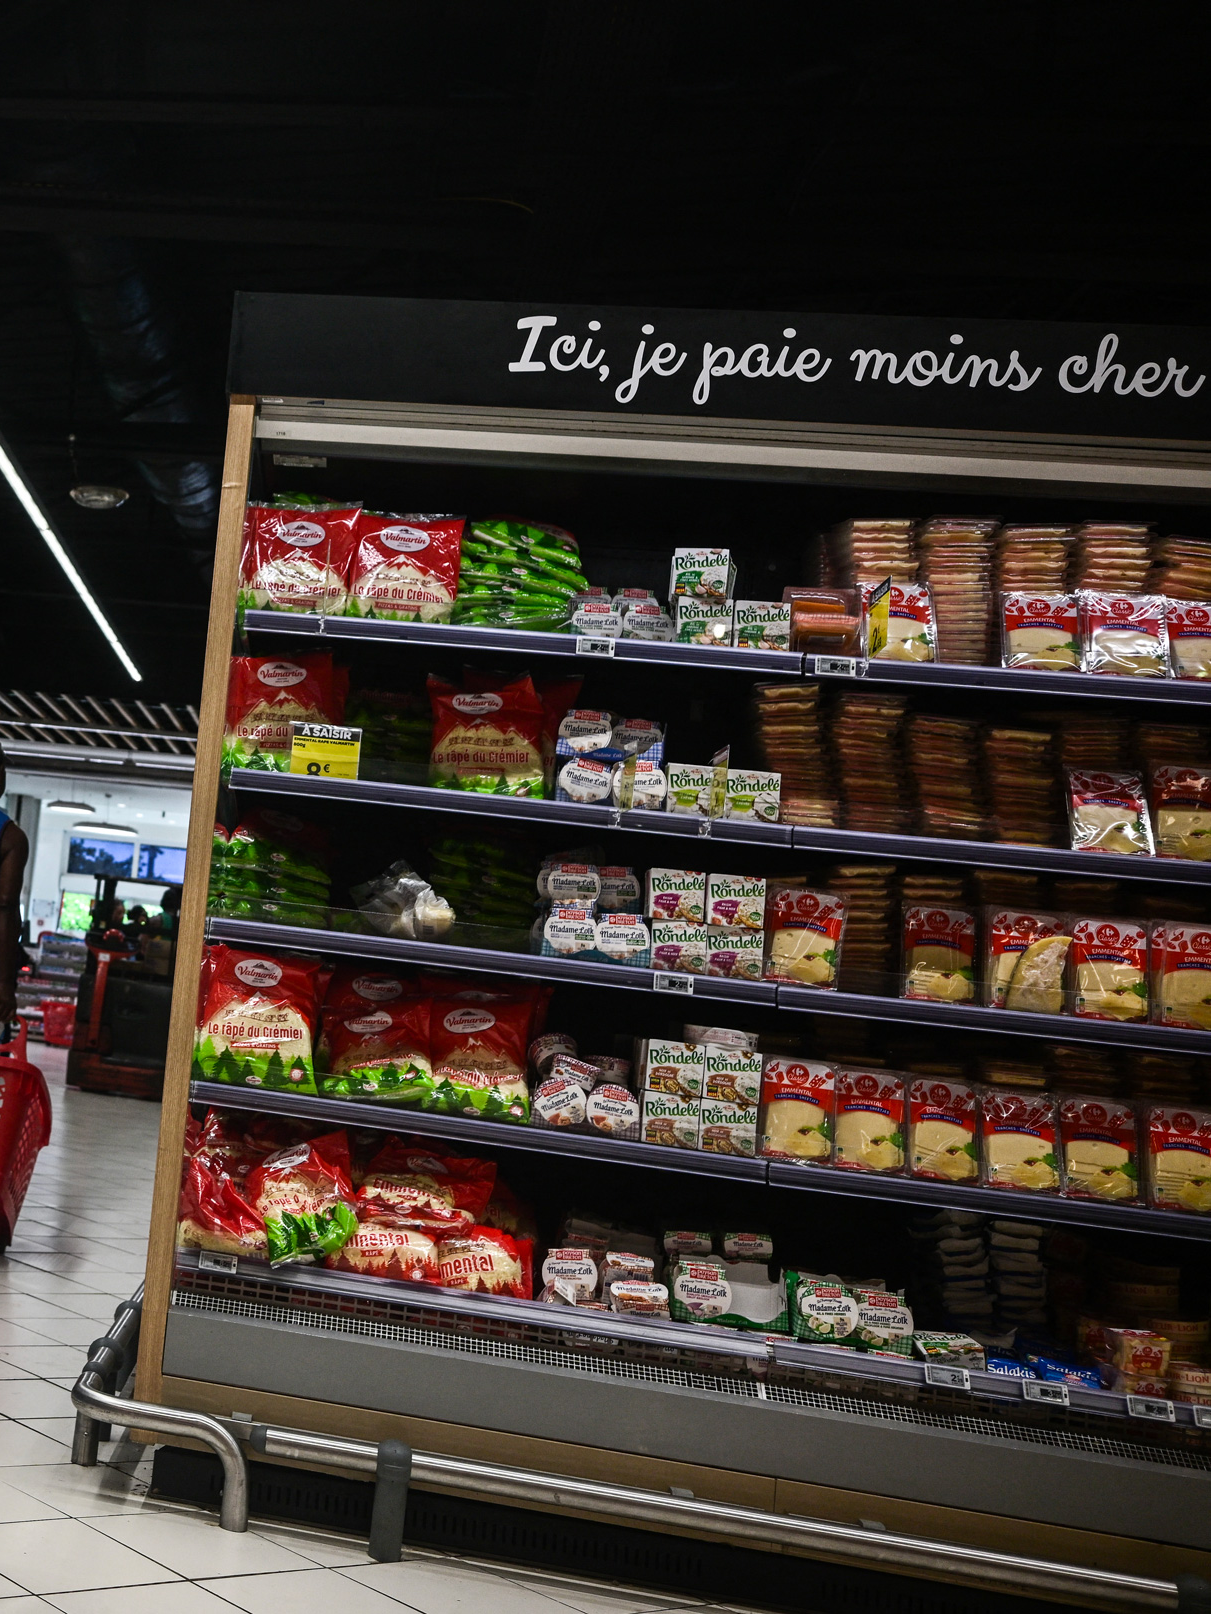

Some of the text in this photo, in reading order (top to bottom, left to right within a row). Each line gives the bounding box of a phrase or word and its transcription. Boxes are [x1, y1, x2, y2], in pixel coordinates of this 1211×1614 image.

[508, 315, 1207, 406] Ici, je paie moins cher
[383, 533, 427, 545] Valmartin
[675, 553, 728, 571] Rondelé
[392, 587, 404, 599] du
[679, 602, 732, 620] Rondelé
[736, 607, 790, 625] Rondelé
[575, 617, 603, 626] Madame
[627, 618, 654, 627] Madame
[260, 669, 304, 680] Valmartin
[456, 697, 500, 708] Valmartin
[237, 725, 248, 738] Le
[276, 726, 288, 737] du
[312, 727, 352, 740] SAISIR
[564, 724, 593, 733] Madame
[433, 751, 444, 763] Le
[446, 749, 470, 766] râpé
[473, 751, 485, 763] du
[489, 748, 530, 763] Crémier
[324, 763, 330, 773] €
[566, 770, 594, 782] Madame
[670, 773, 711, 789] Ronde
[727, 777, 780, 794] Rondelé
[552, 877, 580, 886] Madame
[652, 877, 705, 892] Rondelé
[710, 883, 765, 898] Rondelé
[549, 924, 578, 933] Madame
[600, 930, 629, 939] Madame
[652, 928, 707, 943] Rondelé
[708, 935, 763, 950] Rondelé
[237, 966, 279, 981] Valmartin
[355, 980, 399, 993] Valmartin
[446, 1017, 492, 1027] Valmartin
[208, 1022, 219, 1034] Le
[221, 1022, 245, 1039] râpé
[247, 1025, 260, 1038] du
[650, 1049, 703, 1065] Rondelé
[707, 1056, 761, 1073] Rondelé
[781, 1087, 813, 1096] EMMENTAL
[593, 1101, 620, 1112] Madame
[645, 1101, 700, 1117] Rondelé
[851, 1098, 883, 1107] EMMENTAL
[702, 1108, 757, 1125] Rondelé
[1168, 1136, 1202, 1147] EMMENTAL
[546, 1266, 578, 1274] Madame
[679, 1283, 710, 1295] Madame
[808, 1303, 837, 1312] Madame
[859, 1311, 891, 1323] Madame
[987, 1363, 1037, 1379] Salakis
[1046, 1363, 1100, 1382] Salakis
